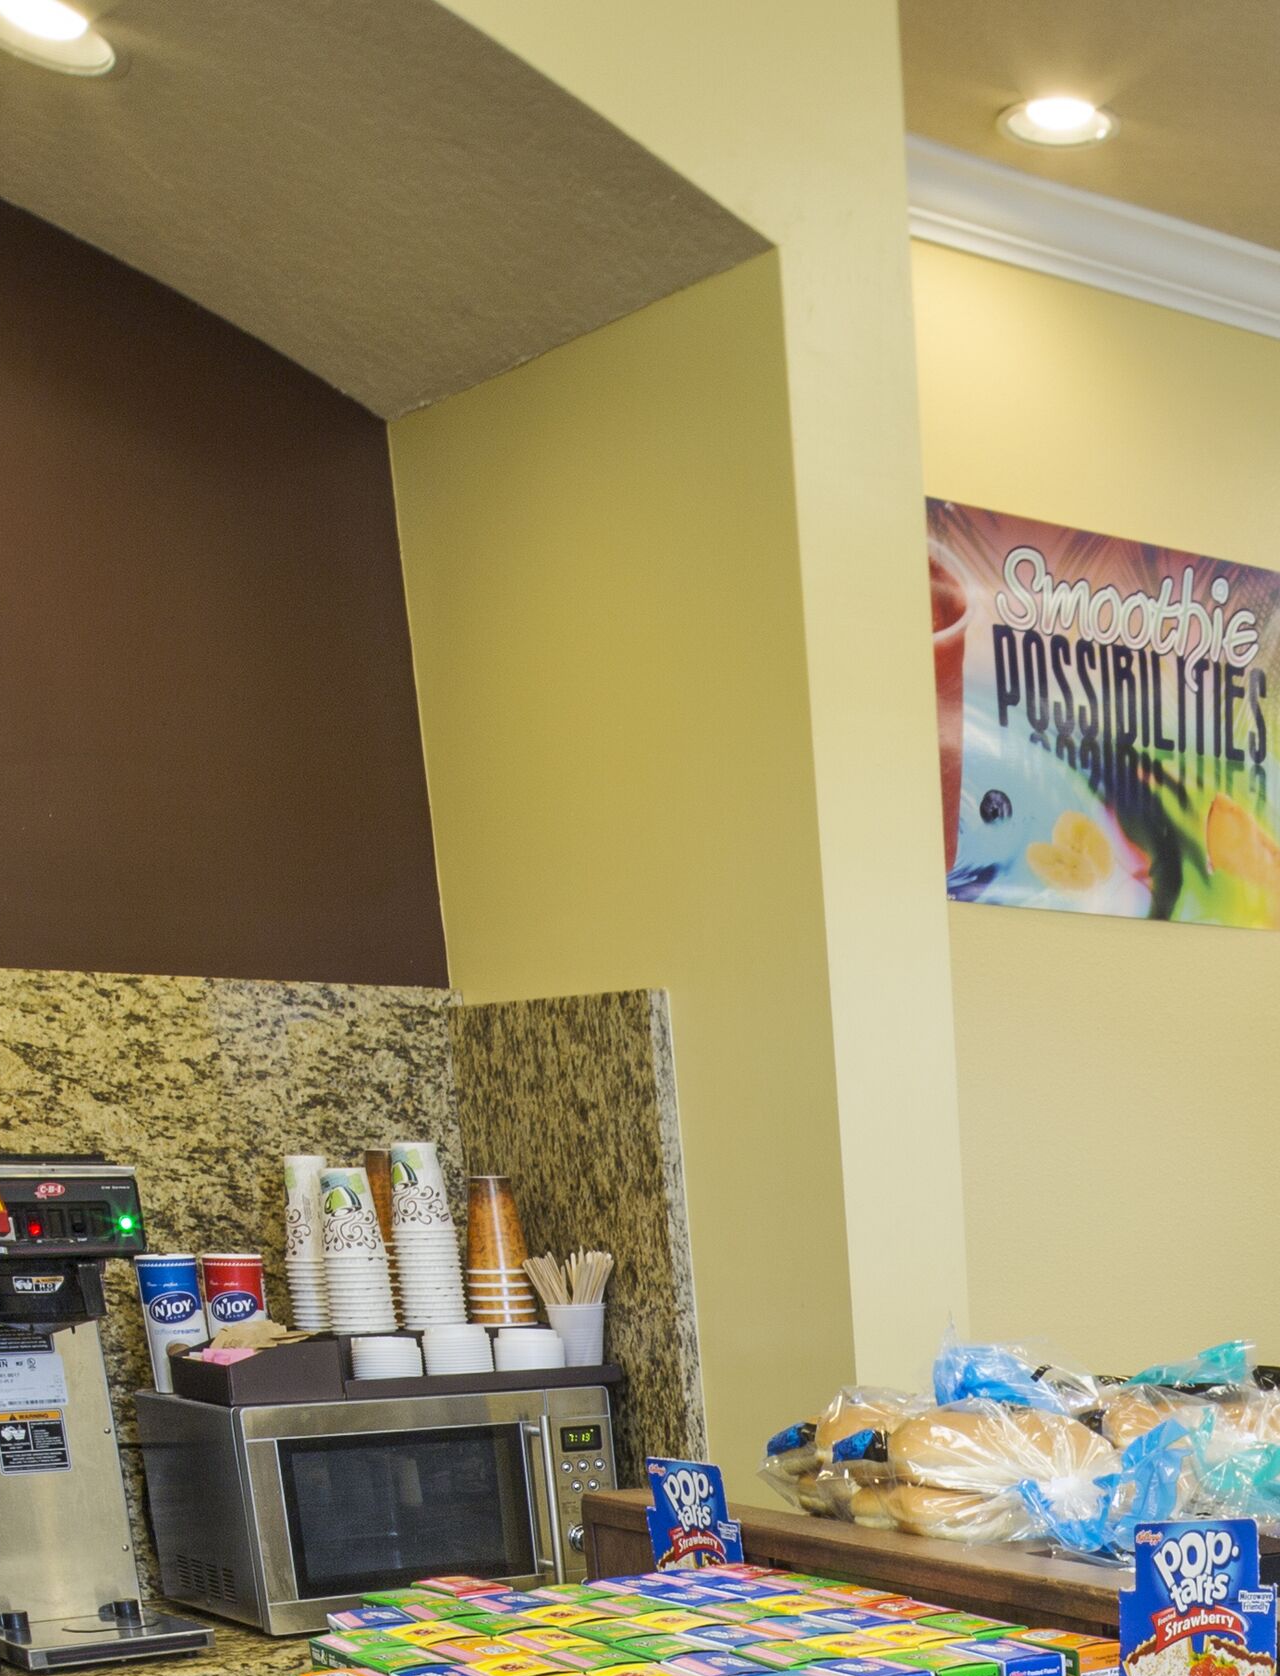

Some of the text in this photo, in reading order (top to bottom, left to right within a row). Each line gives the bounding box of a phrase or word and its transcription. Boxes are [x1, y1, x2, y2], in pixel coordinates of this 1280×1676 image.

[996, 545, 1259, 692] Smoothie
[992, 625, 1267, 764] POSSIBILITIES
[677, 1532, 718, 1552] Strawberry
[1171, 1573, 1229, 1613] tarts
[1239, 1591, 1273, 1601] Microwave
[1242, 1602, 1270, 1614] Friendly
[1164, 1609, 1235, 1642] Strawberry
